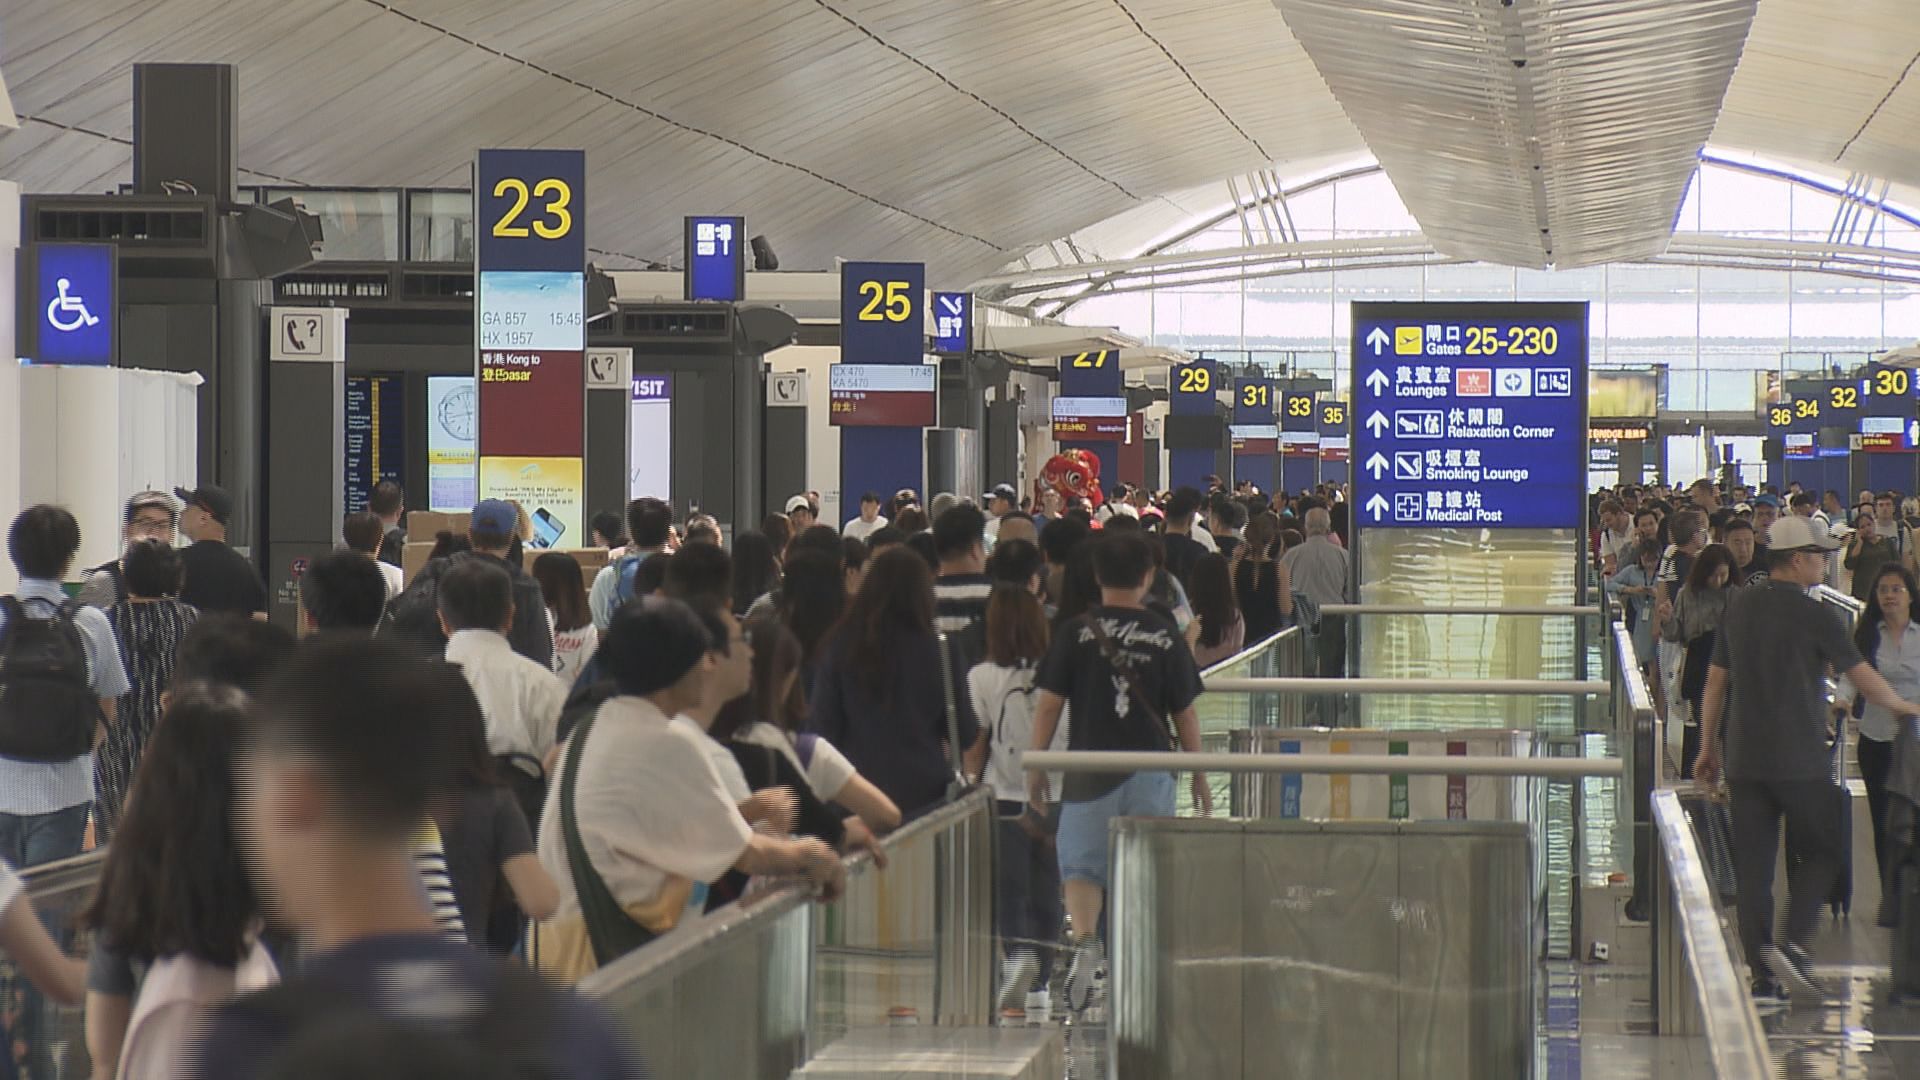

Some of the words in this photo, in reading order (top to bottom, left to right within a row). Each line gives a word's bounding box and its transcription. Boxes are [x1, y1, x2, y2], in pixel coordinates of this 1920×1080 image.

[492, 178, 571, 239] 23
[859, 281, 911, 322] 25
[482, 312, 501, 325] GA
[505, 312, 527, 325] 857
[550, 312, 581, 325] 15:45
[482, 332, 500, 344] HX
[505, 332, 533, 344] 1957
[1426, 325, 1460, 342] 閘口
[1465, 327, 1558, 355] 25-230
[1426, 343, 1461, 355] Gates
[507, 353, 529, 366] Kong
[531, 354, 540, 365] to
[848, 367, 864, 377] 470
[910, 367, 932, 377] 17:45
[1180, 368, 1210, 392] 29
[1396, 366, 1450, 384] 貴賓室
[833, 379, 846, 388] KA
[1876, 370, 1908, 395] 30
[1243, 386, 1267, 406] 31
[1396, 385, 1447, 398] Lounges
[1831, 387, 1857, 408] 32
[1289, 397, 1311, 416] 33
[1796, 400, 1819, 418] 34
[1323, 408, 1343, 424] 35
[1771, 409, 1791, 426] 36
[1448, 425, 1509, 438] Relaxation
[1513, 425, 1554, 438] Corner
[1426, 449, 1480, 466] 吸煙室
[1426, 467, 1479, 482] Smoking
[1483, 467, 1528, 482] Lounge
[1426, 509, 1472, 521] Medical
[1476, 509, 1502, 521] Post
